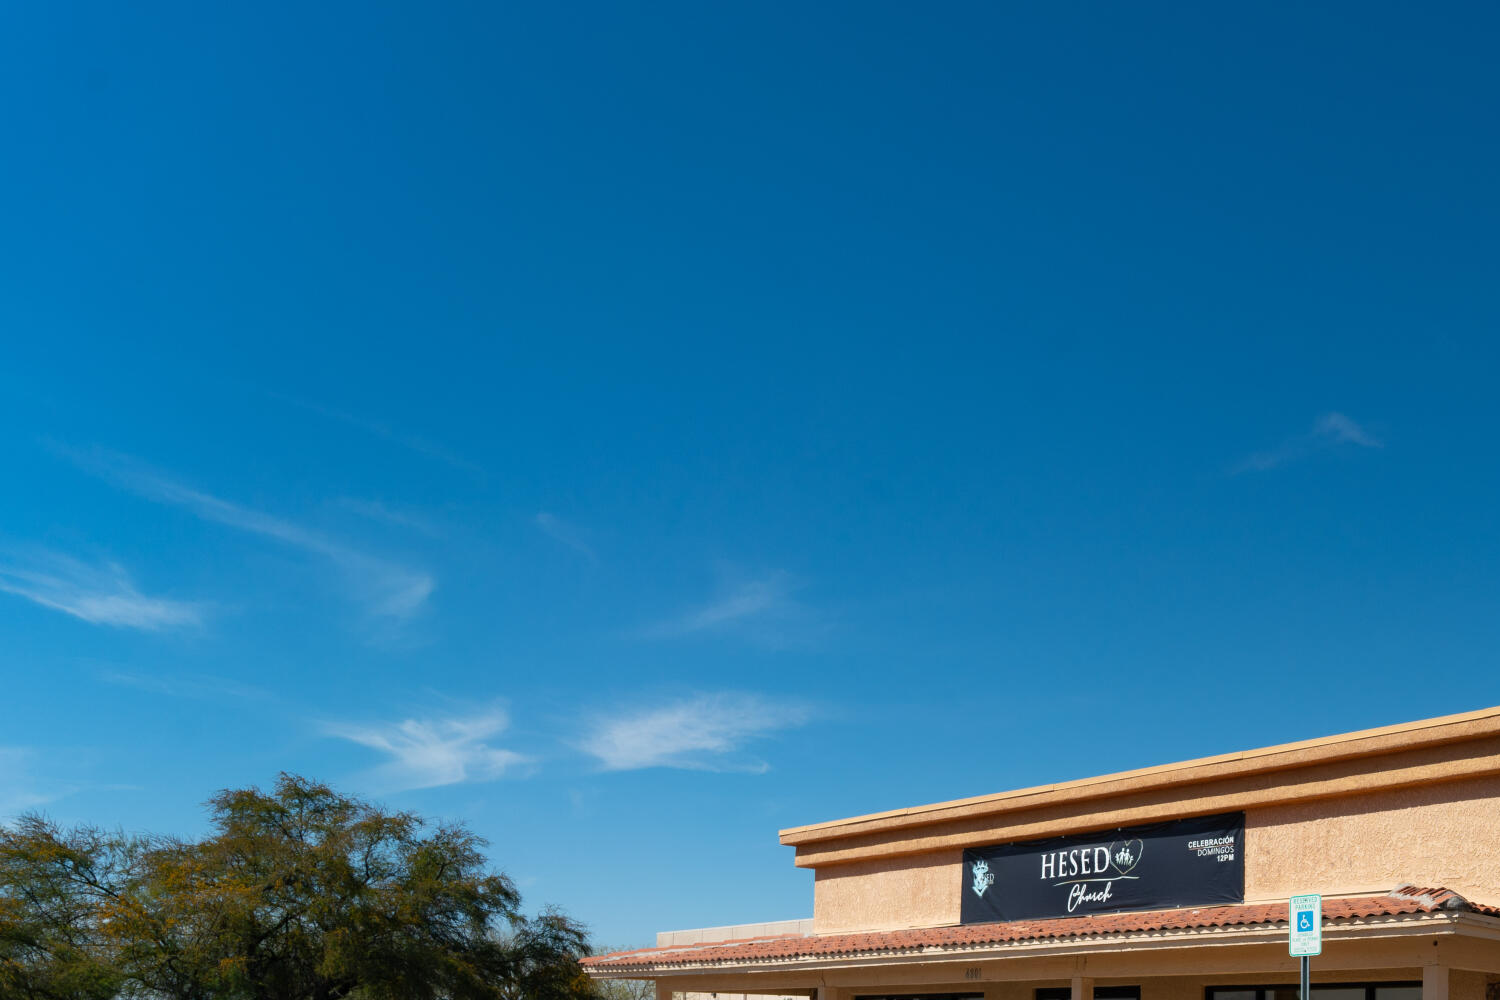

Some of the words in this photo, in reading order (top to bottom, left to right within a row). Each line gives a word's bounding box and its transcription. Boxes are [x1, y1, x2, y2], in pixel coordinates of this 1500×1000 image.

[1188, 836, 1234, 849] CELEBRACIÓN
[1198, 846, 1234, 857] DOMINGOS
[1217, 854, 1234, 862] 12PM
[1040, 847, 1110, 879] HESED
[1067, 881, 1113, 912] Church
